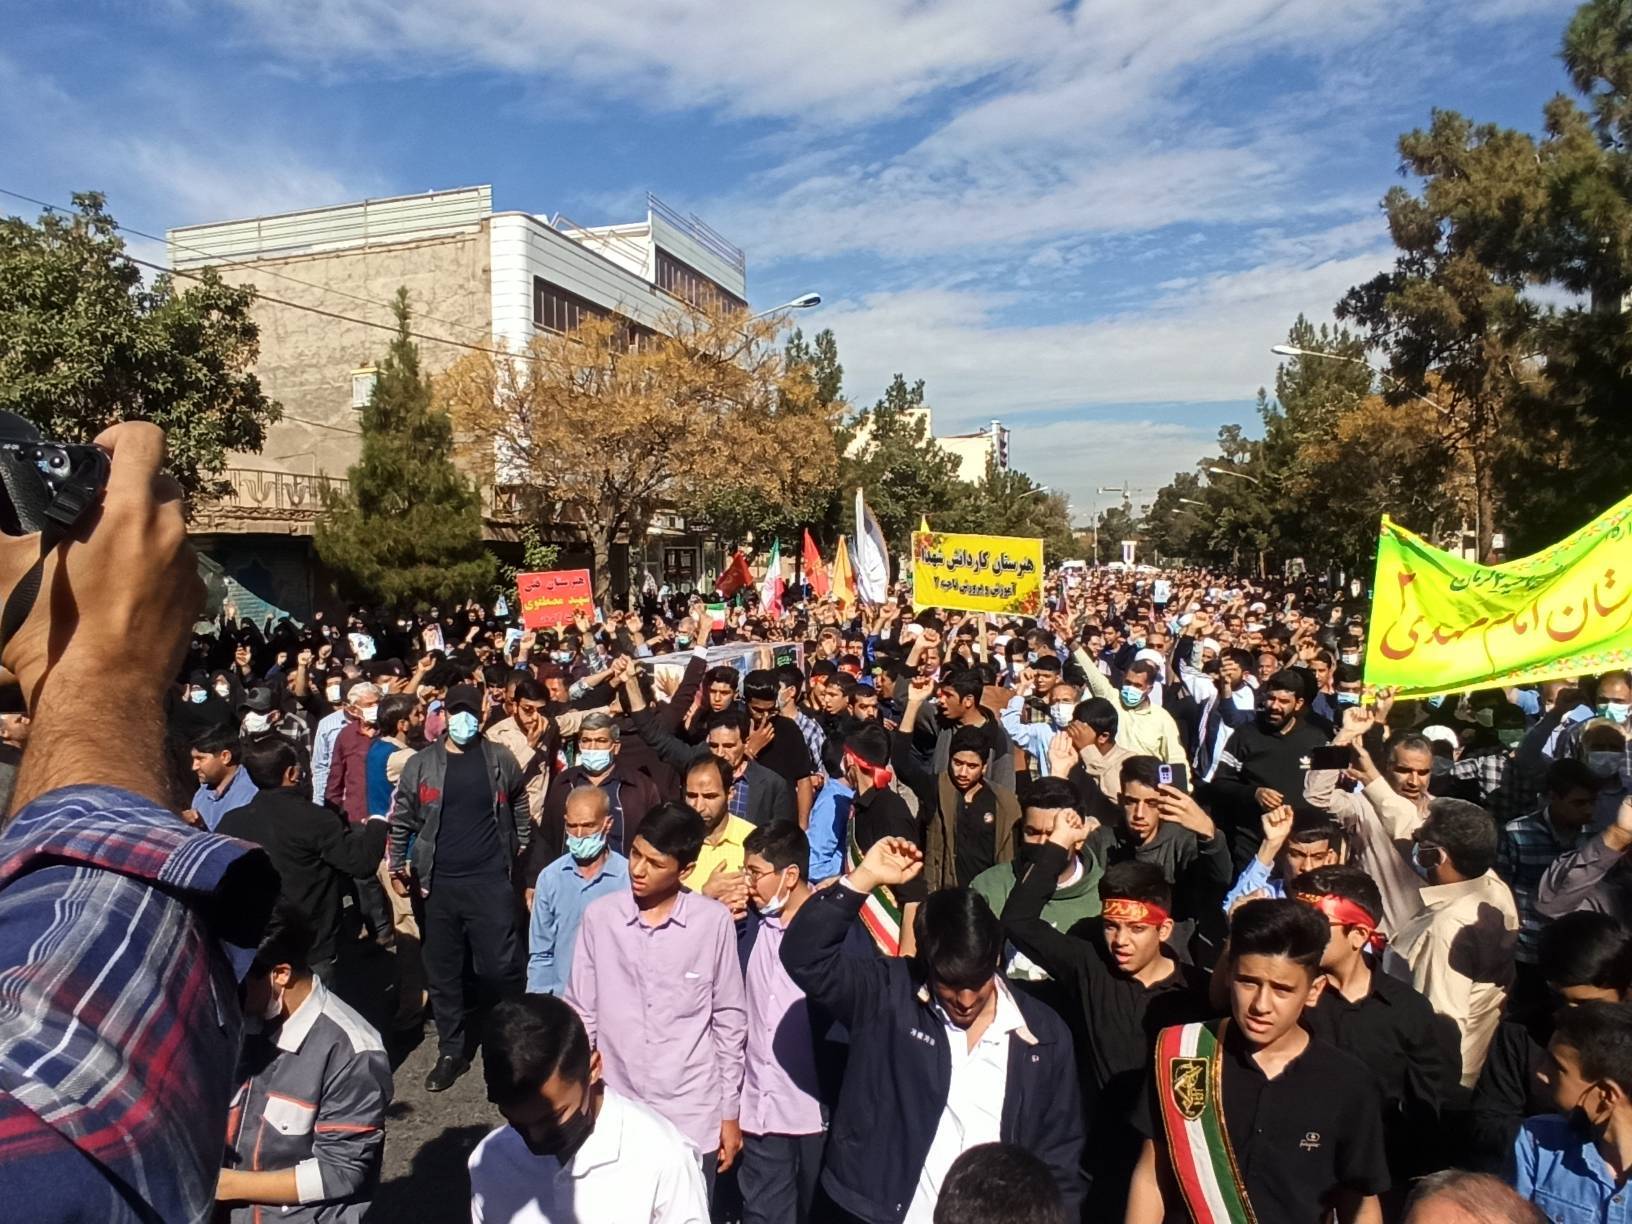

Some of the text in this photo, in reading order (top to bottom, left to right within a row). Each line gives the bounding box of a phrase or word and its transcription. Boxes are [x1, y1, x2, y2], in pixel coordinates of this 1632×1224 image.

[920, 547, 944, 568] شهدا
[992, 552, 1034, 577] هنرستان
[990, 582, 1017, 599] آموزش
